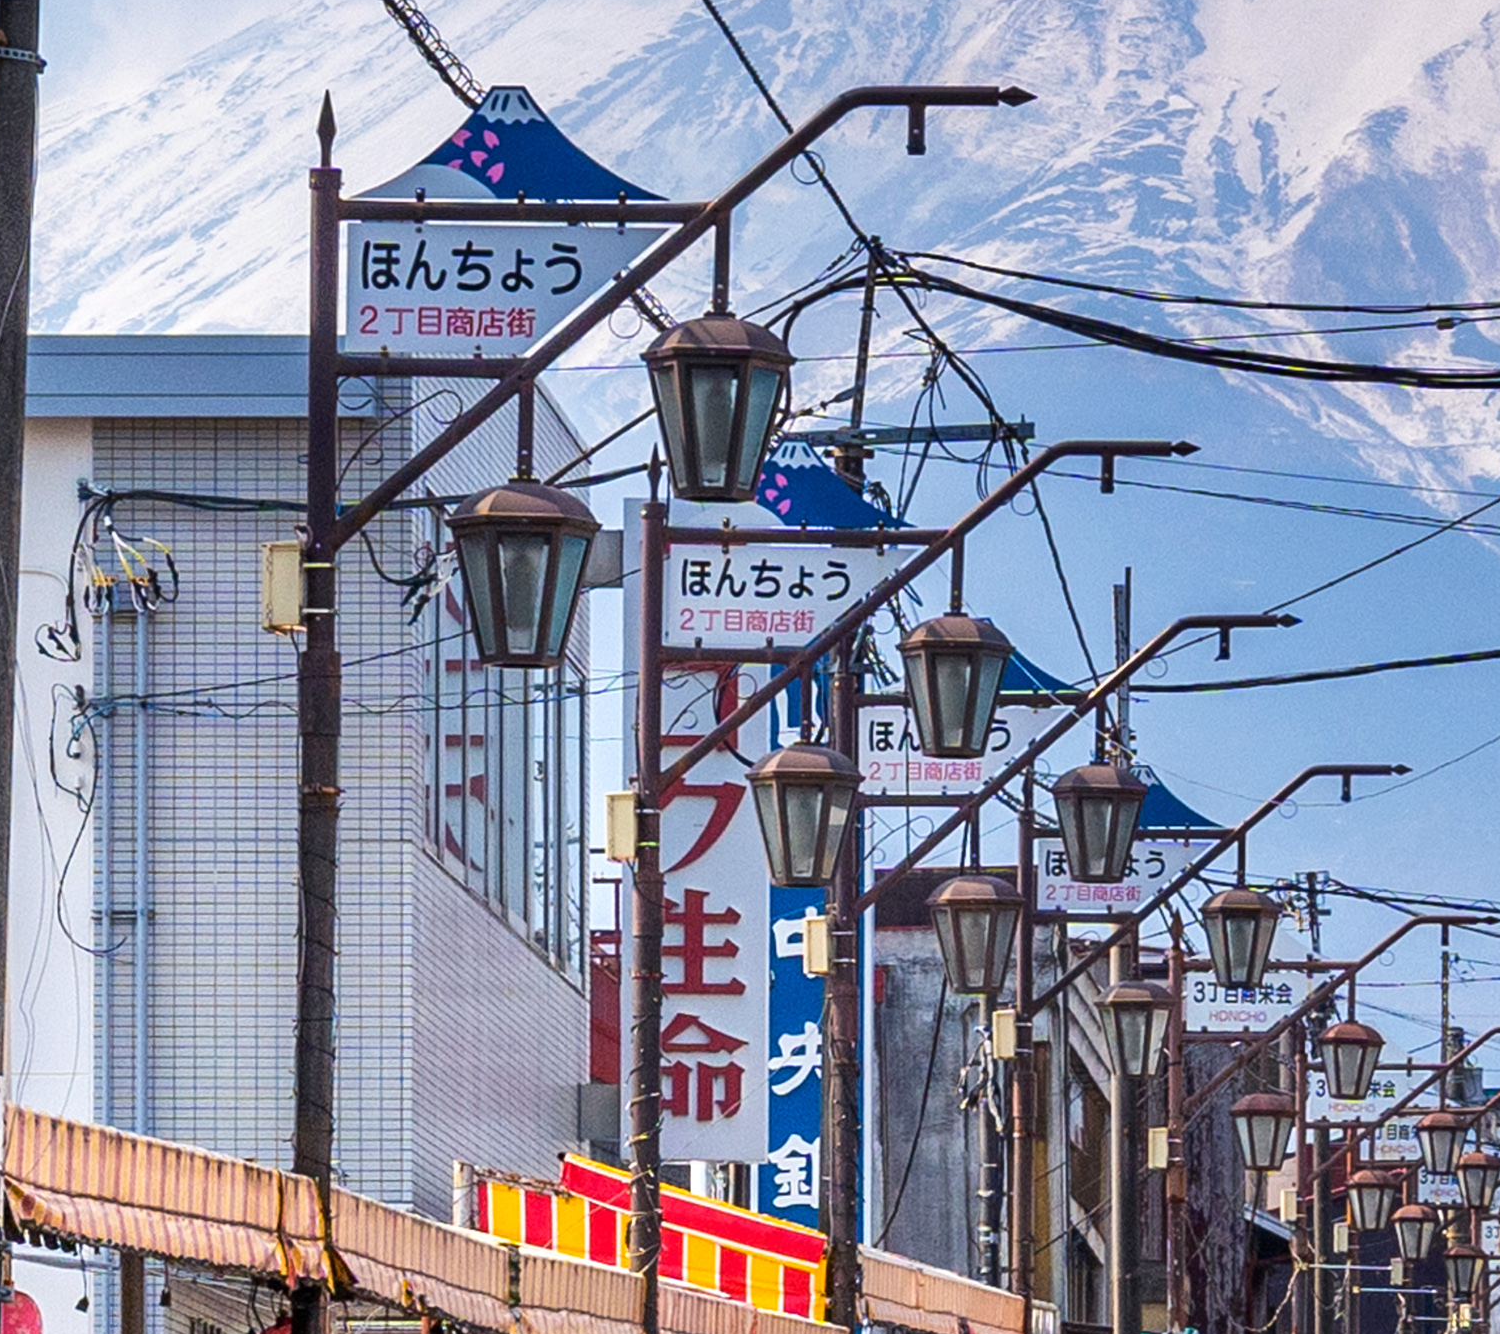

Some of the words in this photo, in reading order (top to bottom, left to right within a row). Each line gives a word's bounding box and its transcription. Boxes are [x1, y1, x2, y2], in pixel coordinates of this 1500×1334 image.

[361, 239, 583, 296] ほんちょう
[359, 304, 537, 338] 2丁目商店街
[680, 558, 852, 602] ほんちょう
[679, 608, 816, 635] 2丁目商店街
[868, 718, 1012, 753] ほんう
[868, 761, 983, 782] 2丁目商店街
[1044, 850, 1167, 880] ほょう
